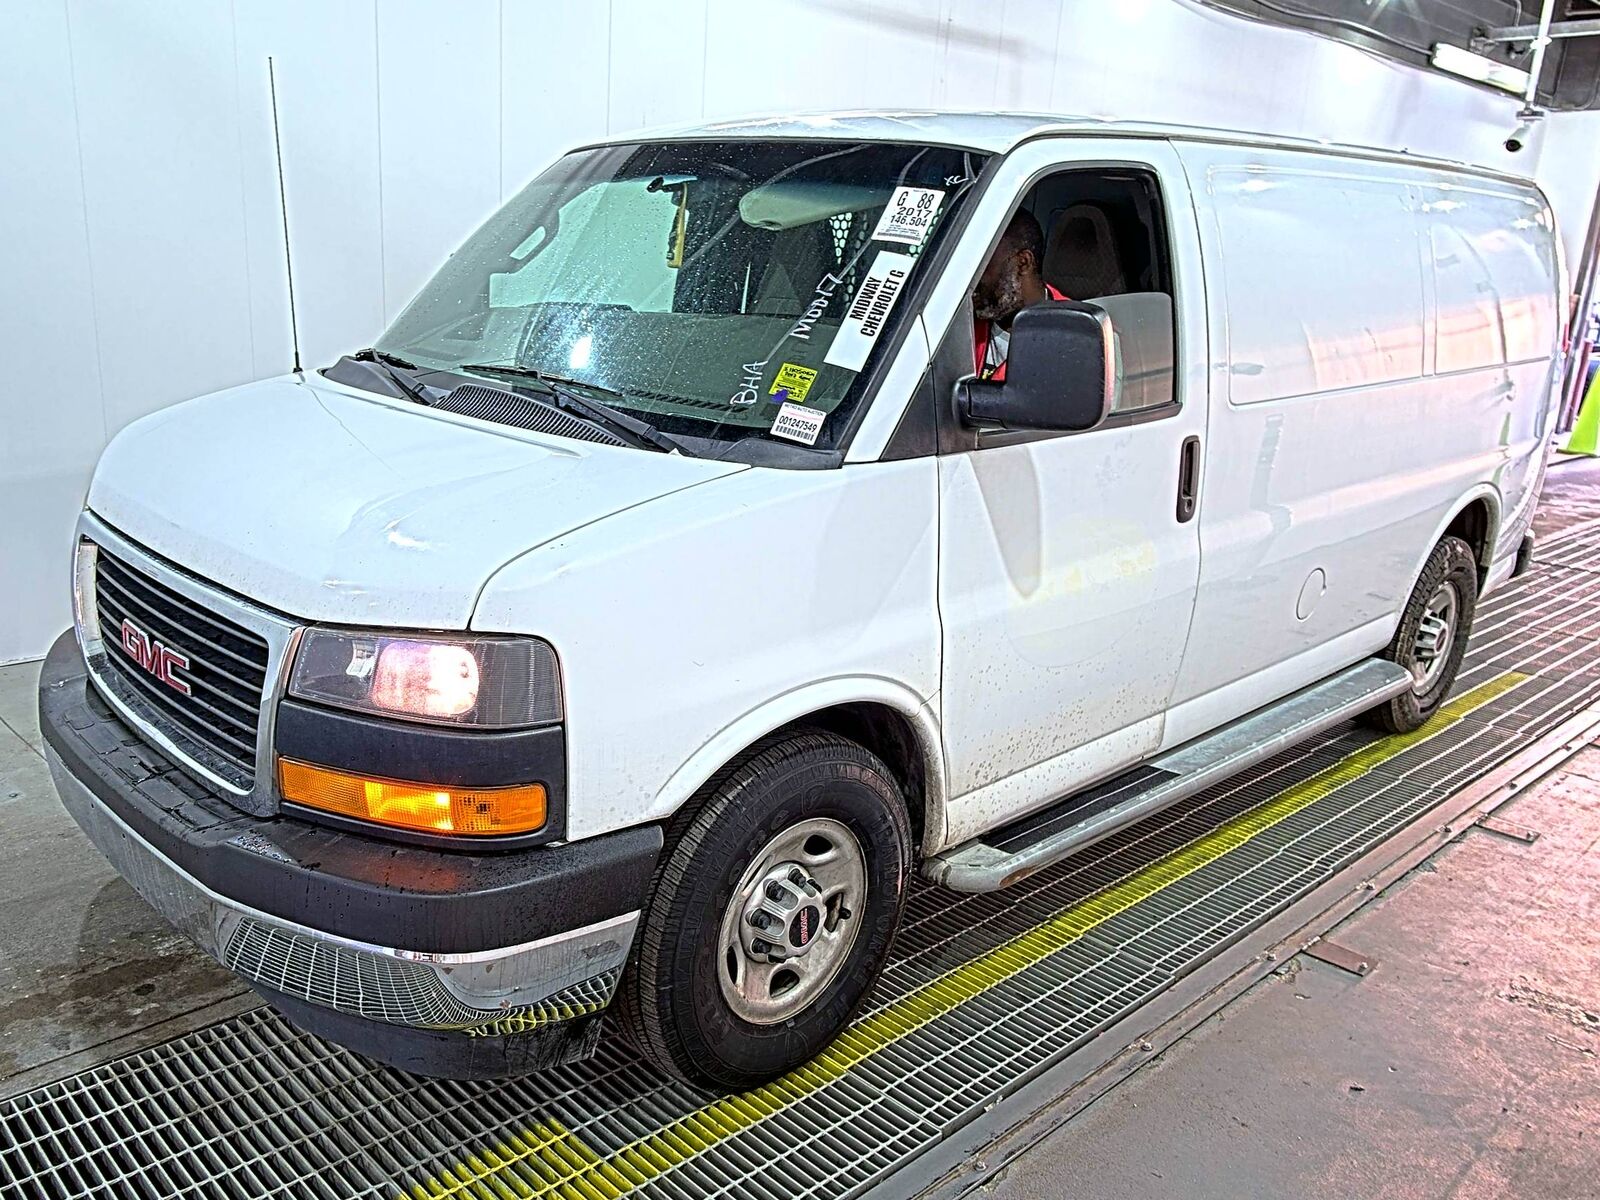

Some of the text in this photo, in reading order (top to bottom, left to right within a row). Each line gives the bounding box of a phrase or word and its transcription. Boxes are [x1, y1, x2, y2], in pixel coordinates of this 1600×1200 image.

[897, 191, 935, 209] G 88
[897, 206, 933, 218] 2017
[849, 276, 882, 320] MIDWAY
[860, 277, 900, 337] CHEVROLET
[889, 269, 905, 278] G
[730, 360, 769, 405] BHA
[778, 415, 818, 433] 001247549
[121, 618, 192, 697] GMC
